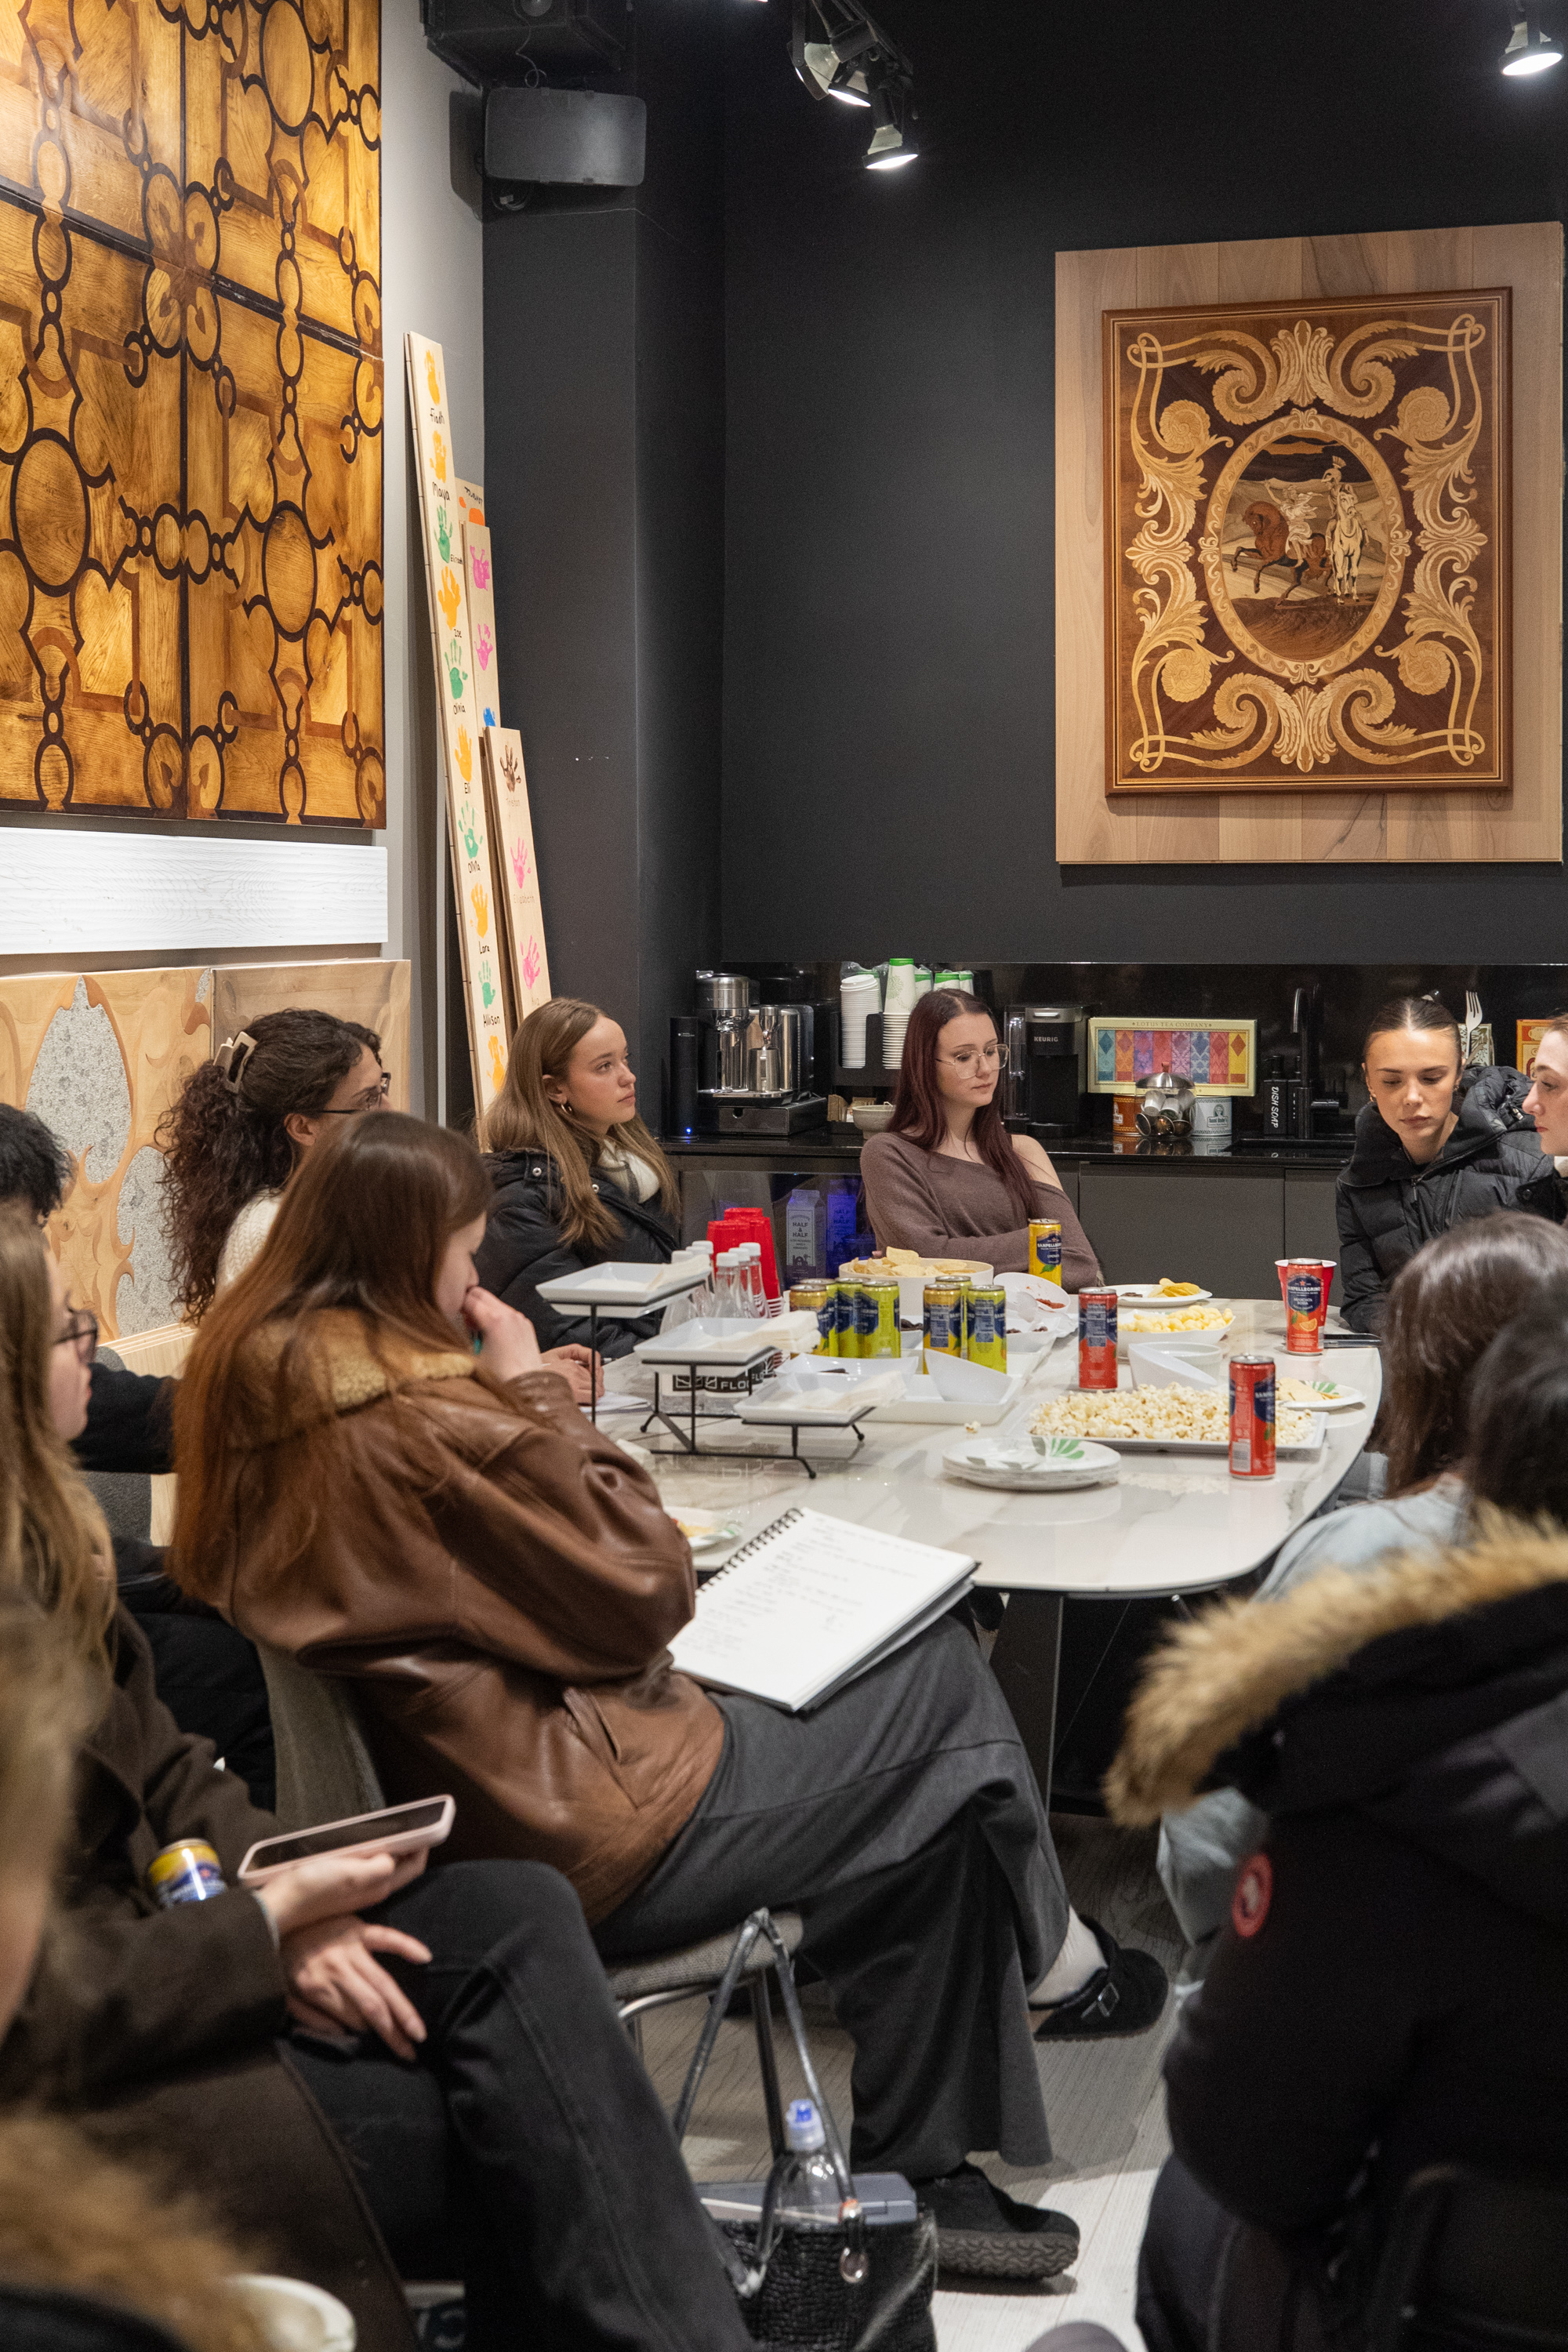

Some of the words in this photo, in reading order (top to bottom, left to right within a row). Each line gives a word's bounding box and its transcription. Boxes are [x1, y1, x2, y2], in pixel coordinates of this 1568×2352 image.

[432, 481, 451, 508] Maya
[478, 941, 490, 954] Lara
[483, 1014, 501, 1028] Allison
[1271, 1086, 1279, 1106] DISH
[1271, 1106, 1279, 1128] SOAP
